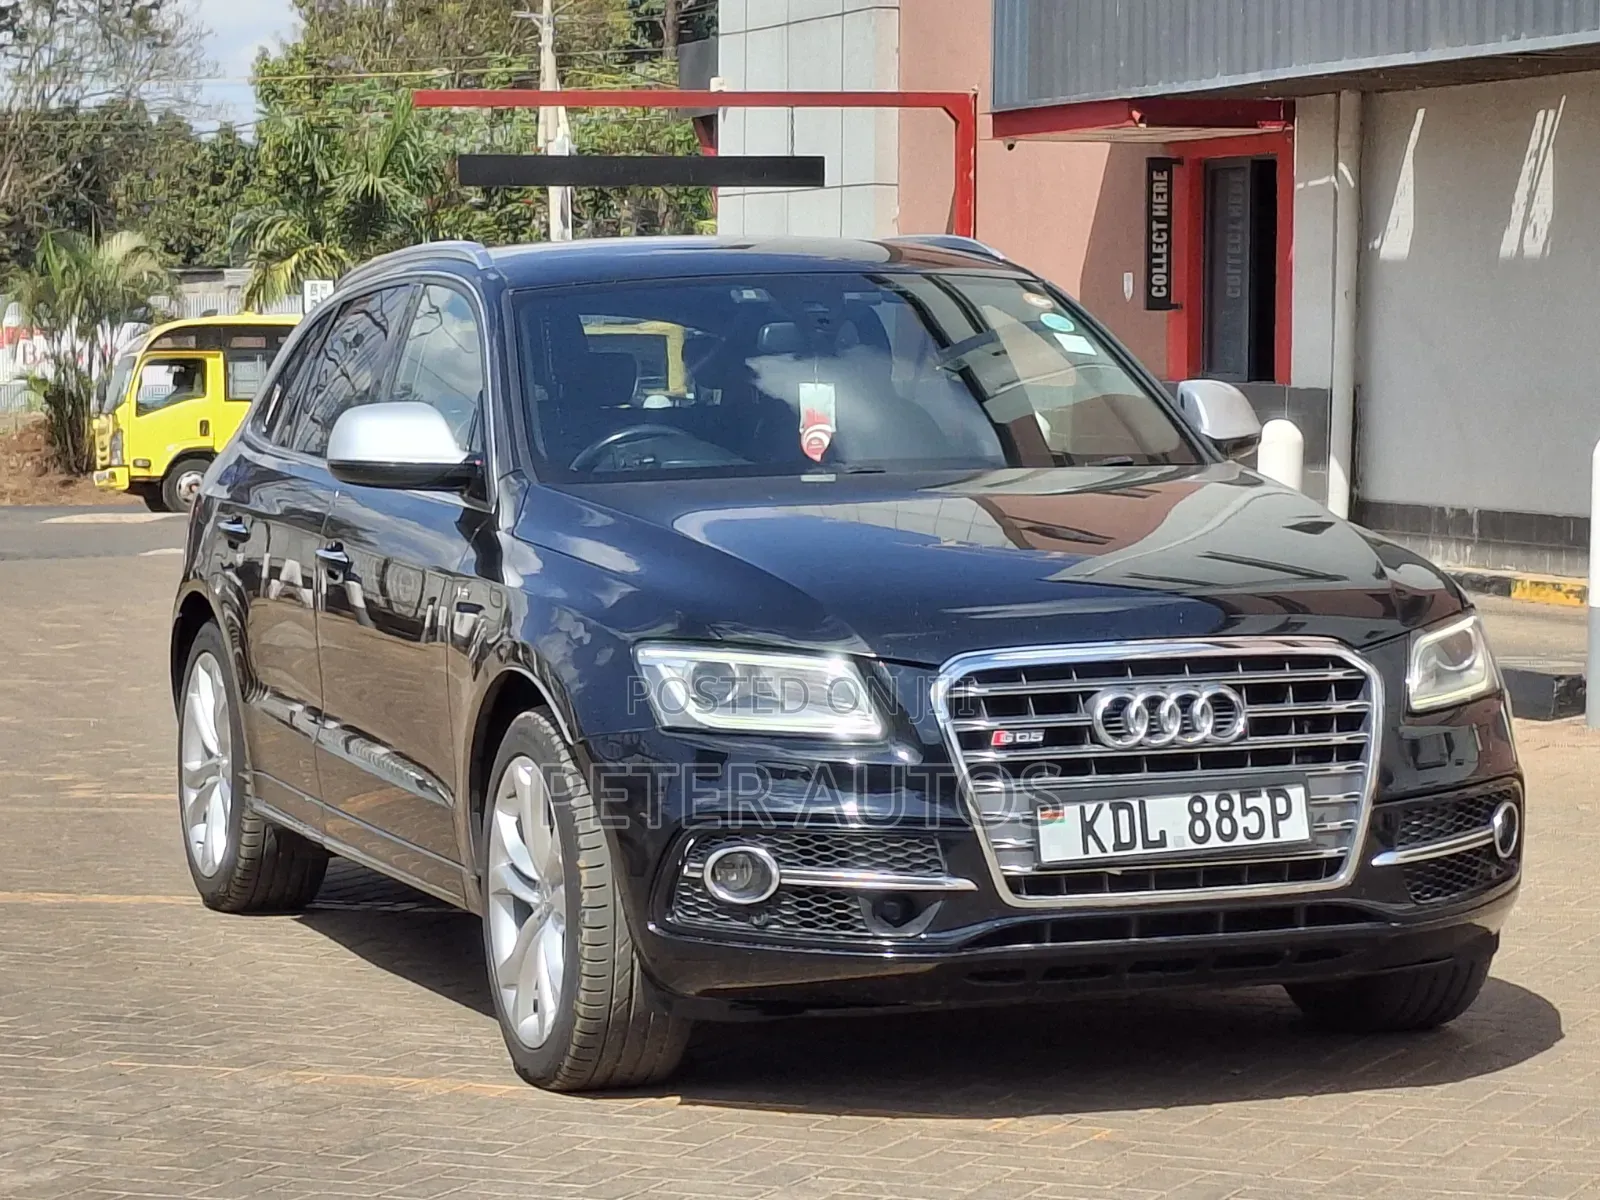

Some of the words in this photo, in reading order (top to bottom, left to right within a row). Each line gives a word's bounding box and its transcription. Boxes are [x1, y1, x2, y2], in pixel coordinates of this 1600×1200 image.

[1152, 170, 1168, 216] HERE
[1151, 221, 1168, 298] COLLECT
[1080, 801, 1167, 854] KDL
[1188, 788, 1292, 844] 885P
